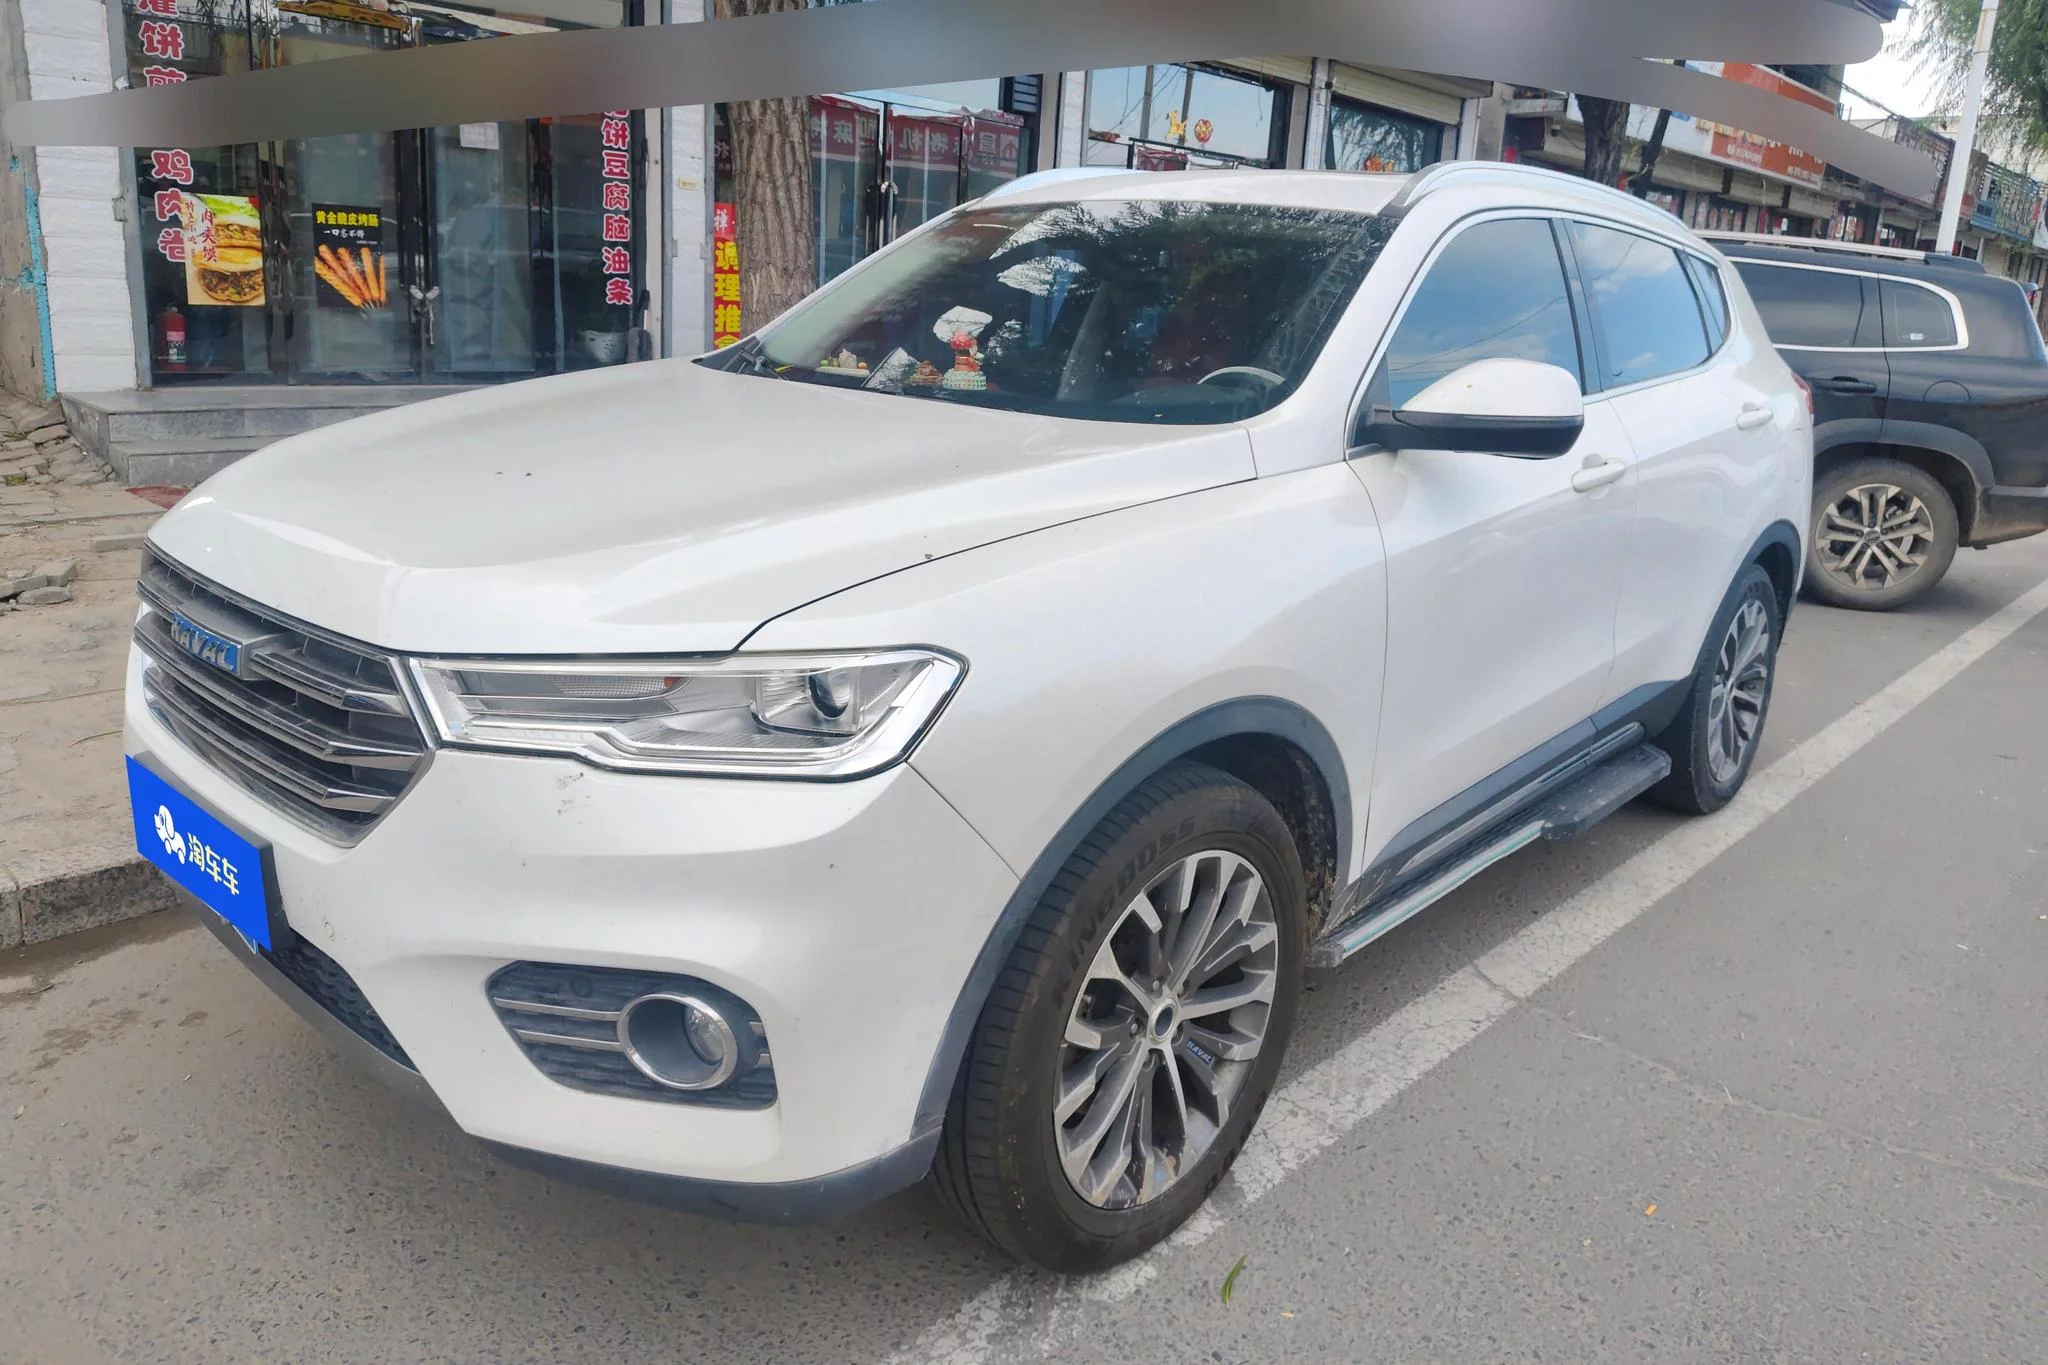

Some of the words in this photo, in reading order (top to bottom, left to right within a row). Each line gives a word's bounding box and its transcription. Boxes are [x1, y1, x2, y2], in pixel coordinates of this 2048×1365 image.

[151, 149, 193, 262] 鸡肉卷
[601, 109, 633, 304] 饼豆腐脑油条
[171, 616, 235, 672] HAVAL
